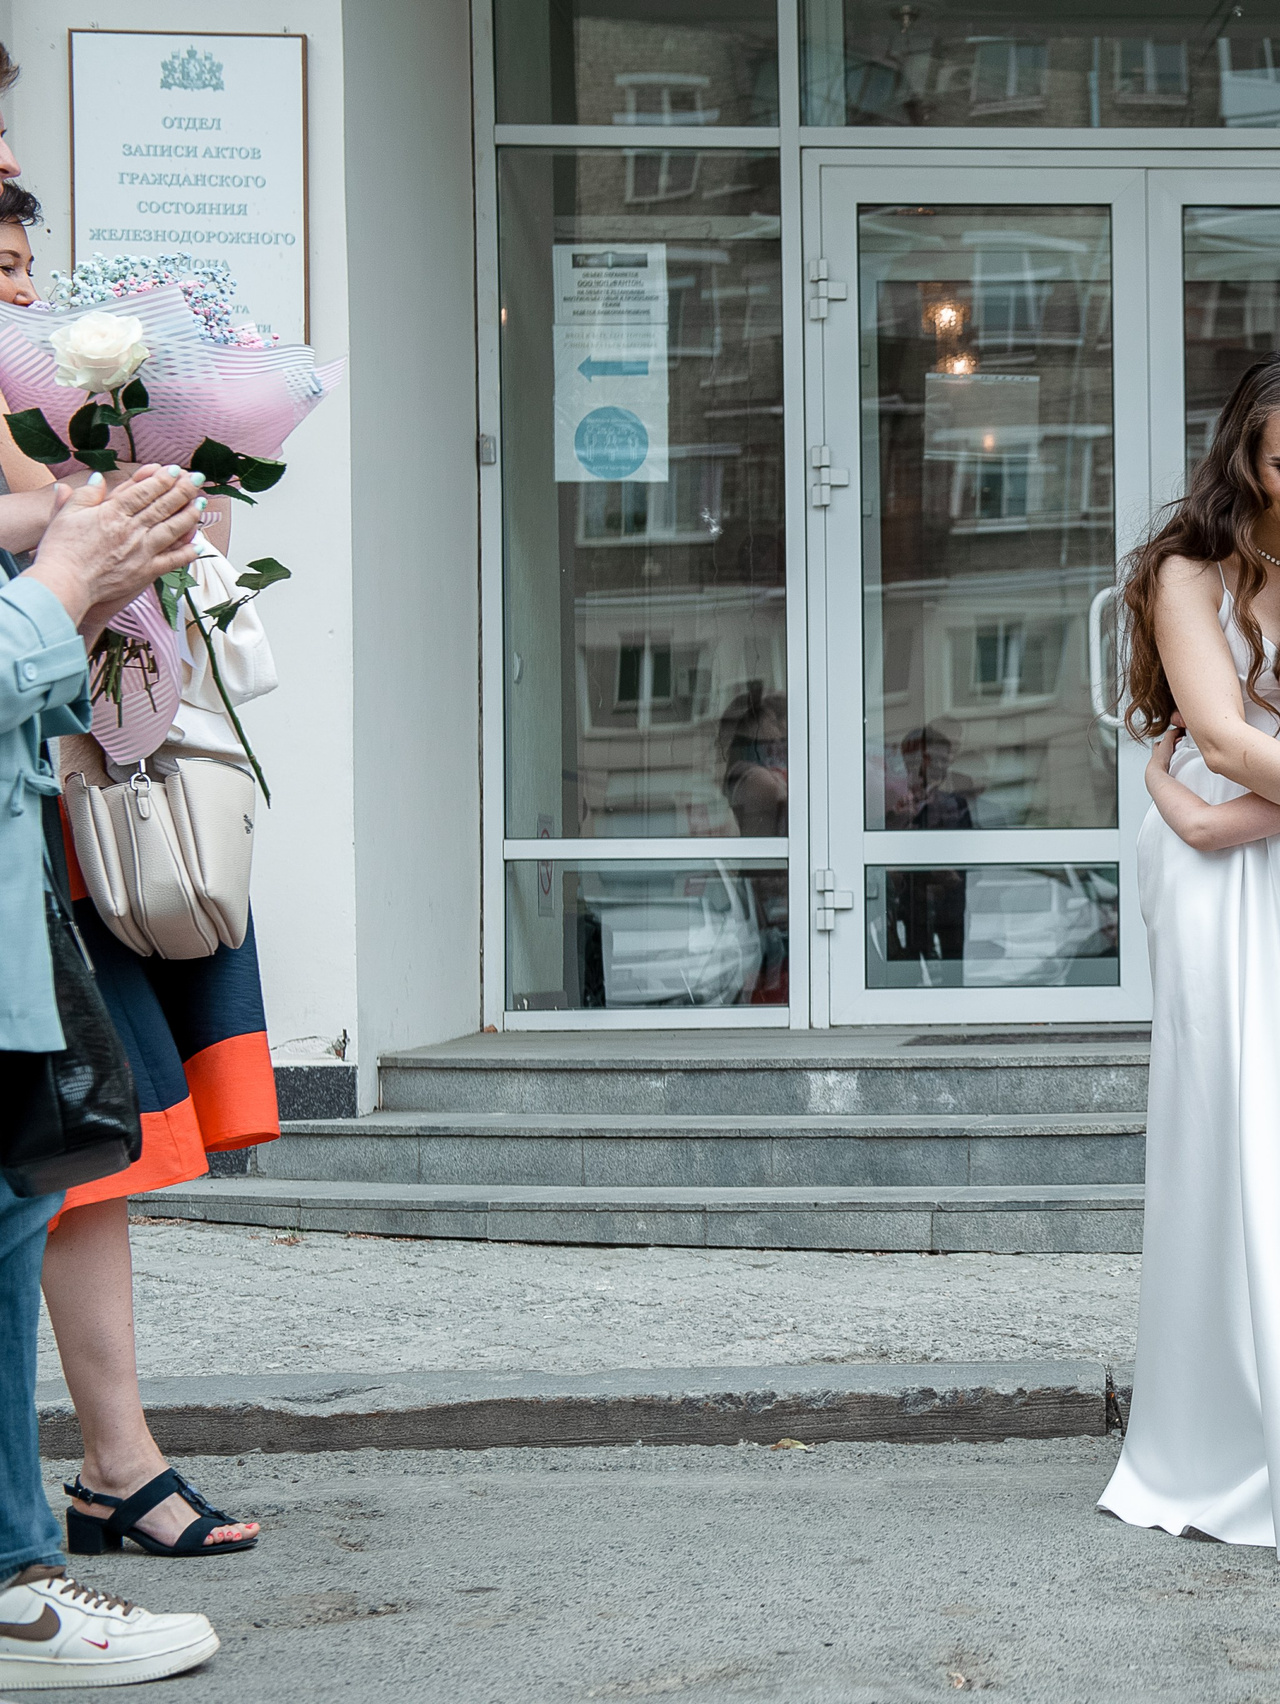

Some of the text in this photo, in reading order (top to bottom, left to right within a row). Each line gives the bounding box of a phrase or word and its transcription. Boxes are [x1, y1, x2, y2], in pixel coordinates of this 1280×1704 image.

[161, 115, 222, 132] ОТДЕЛ
[121, 143, 262, 160] ЗАПИСИ АКТОВ
[117, 171, 267, 189] ГРАЖДАНСКОГО
[137, 200, 248, 217] СОСТОЯНИЯ
[88, 227, 297, 246] ЖЕЛЕЗНОДОРОЖНОГО
